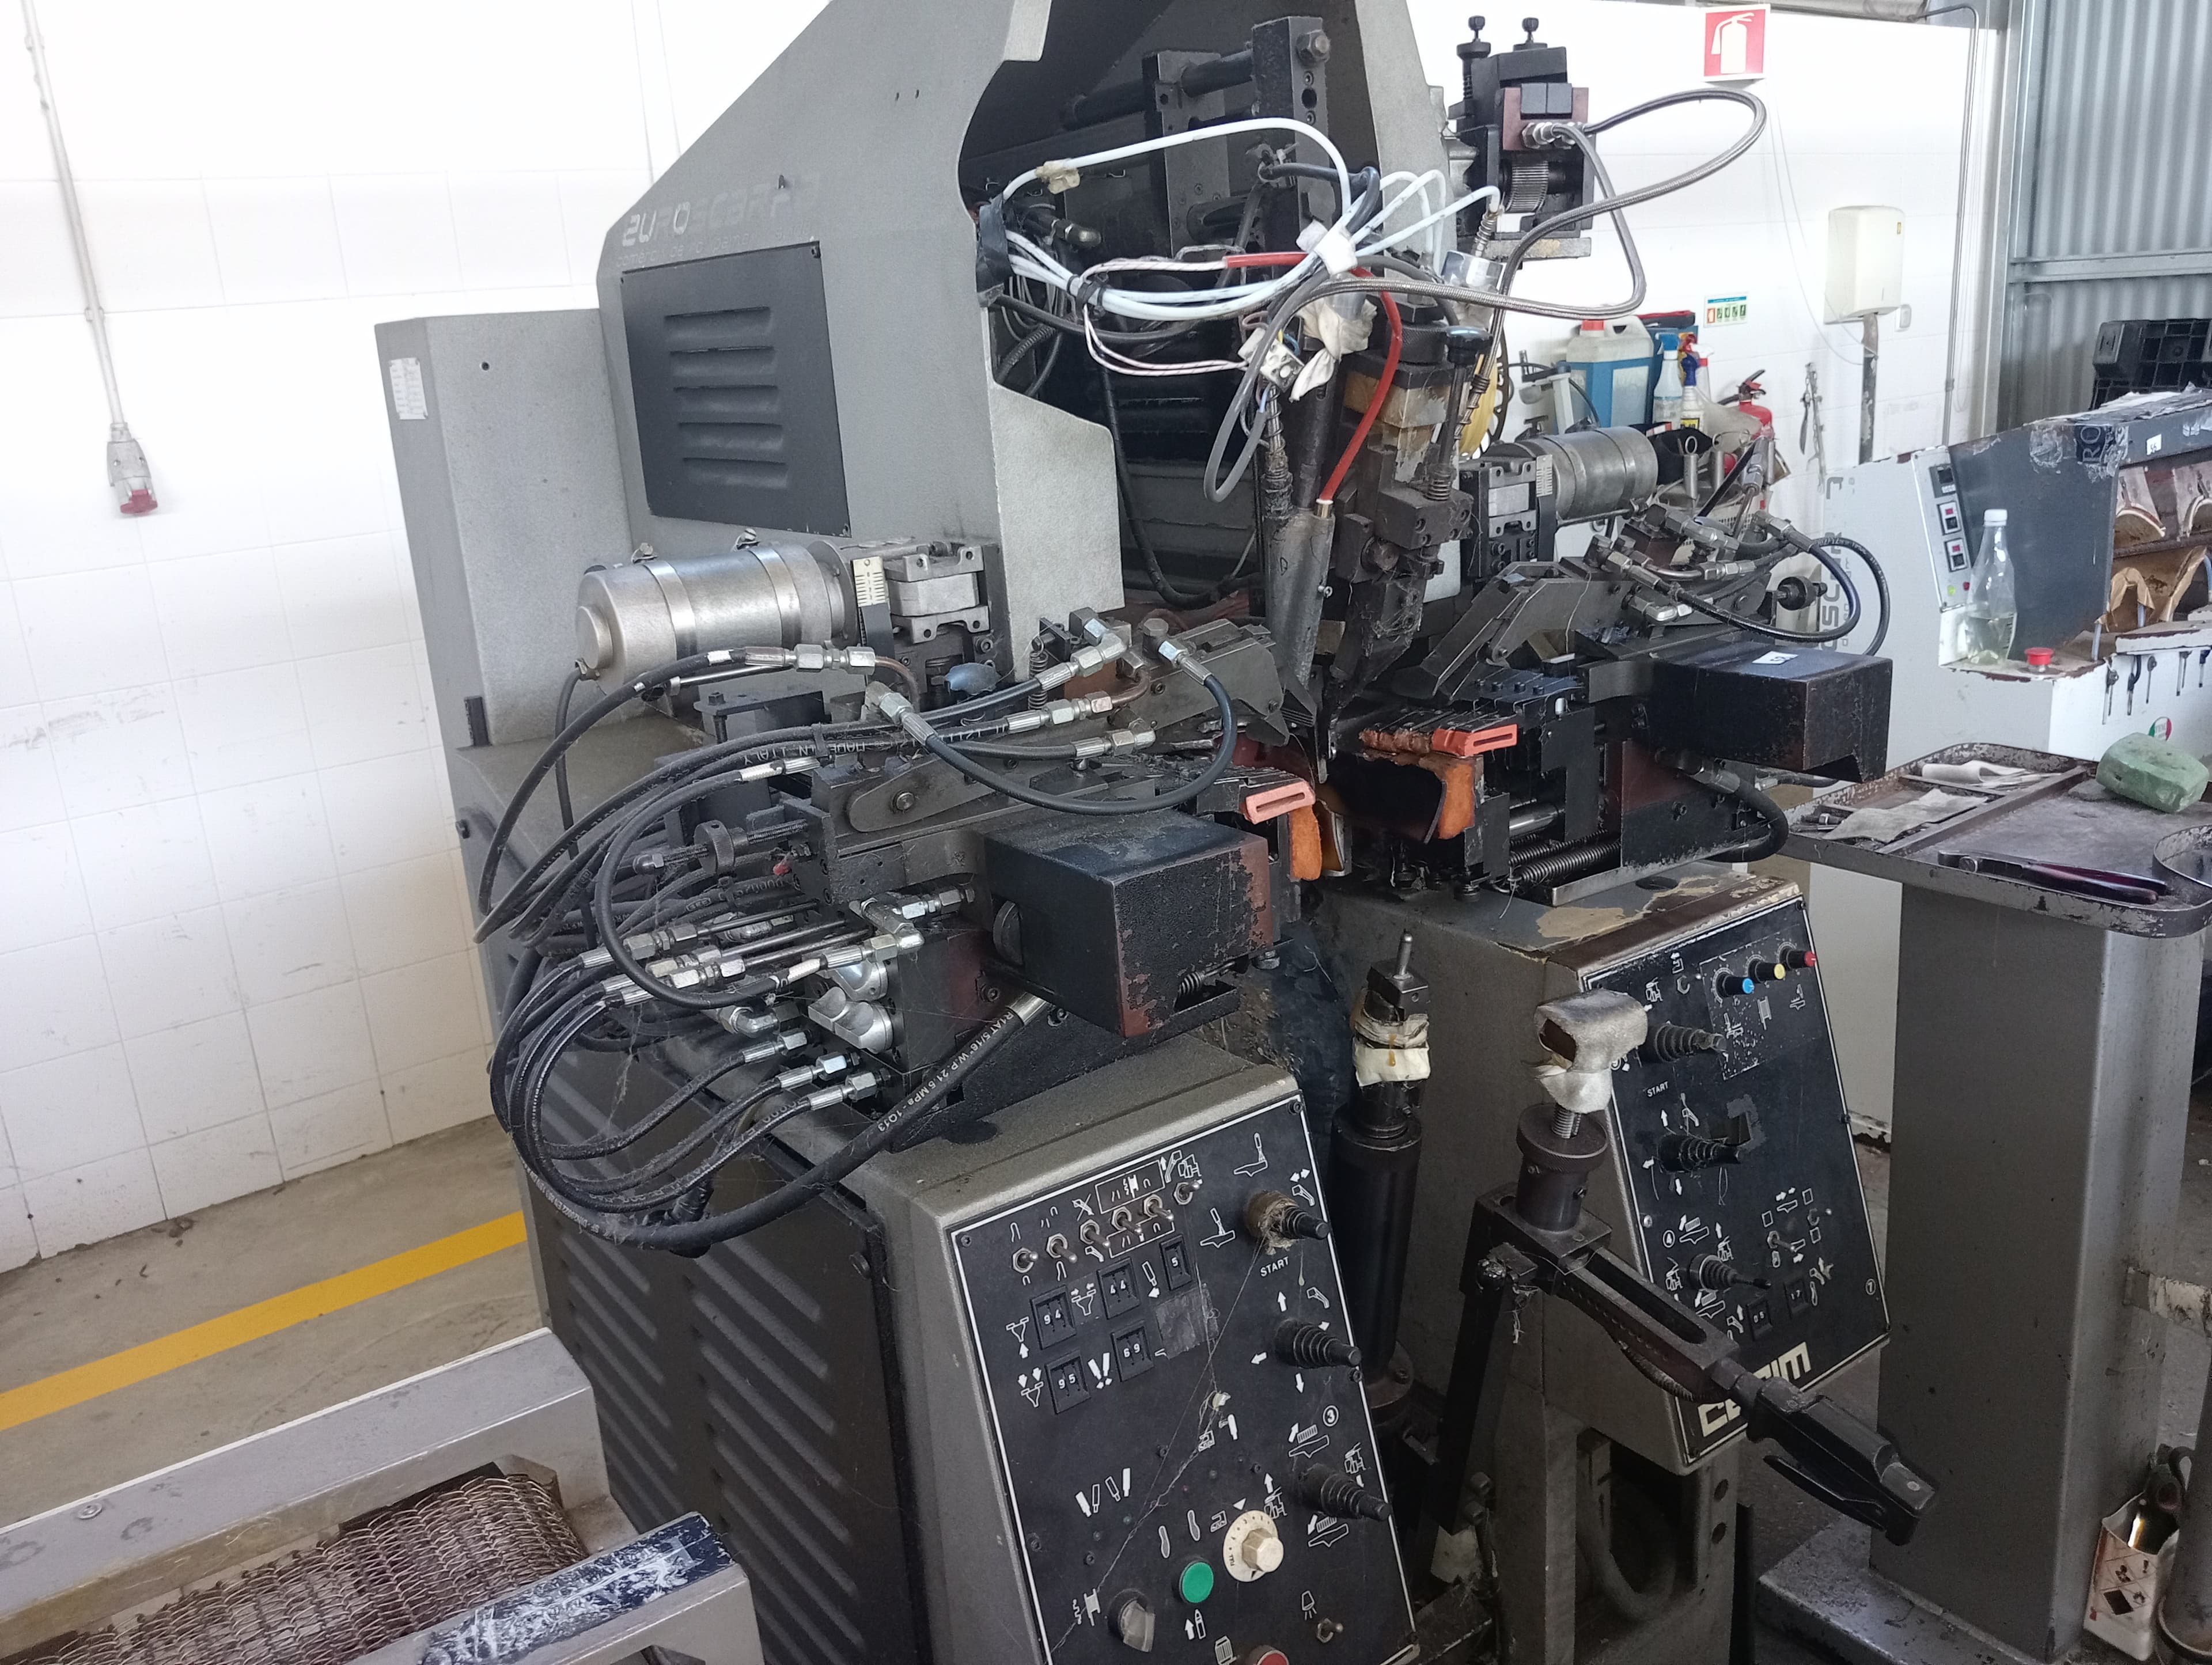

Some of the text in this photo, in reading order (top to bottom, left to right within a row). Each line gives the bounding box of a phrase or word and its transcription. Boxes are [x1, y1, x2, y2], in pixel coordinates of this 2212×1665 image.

[990, 1011, 1014, 1034] R1AT
[907, 1086, 930, 1106] MPa
[1647, 1080, 1668, 1097] START
[1171, 1257, 1179, 1267] 5
[1260, 1256, 1290, 1277] START
[1123, 1343, 1141, 1358] 69
[1058, 1373, 1076, 1389] 95
